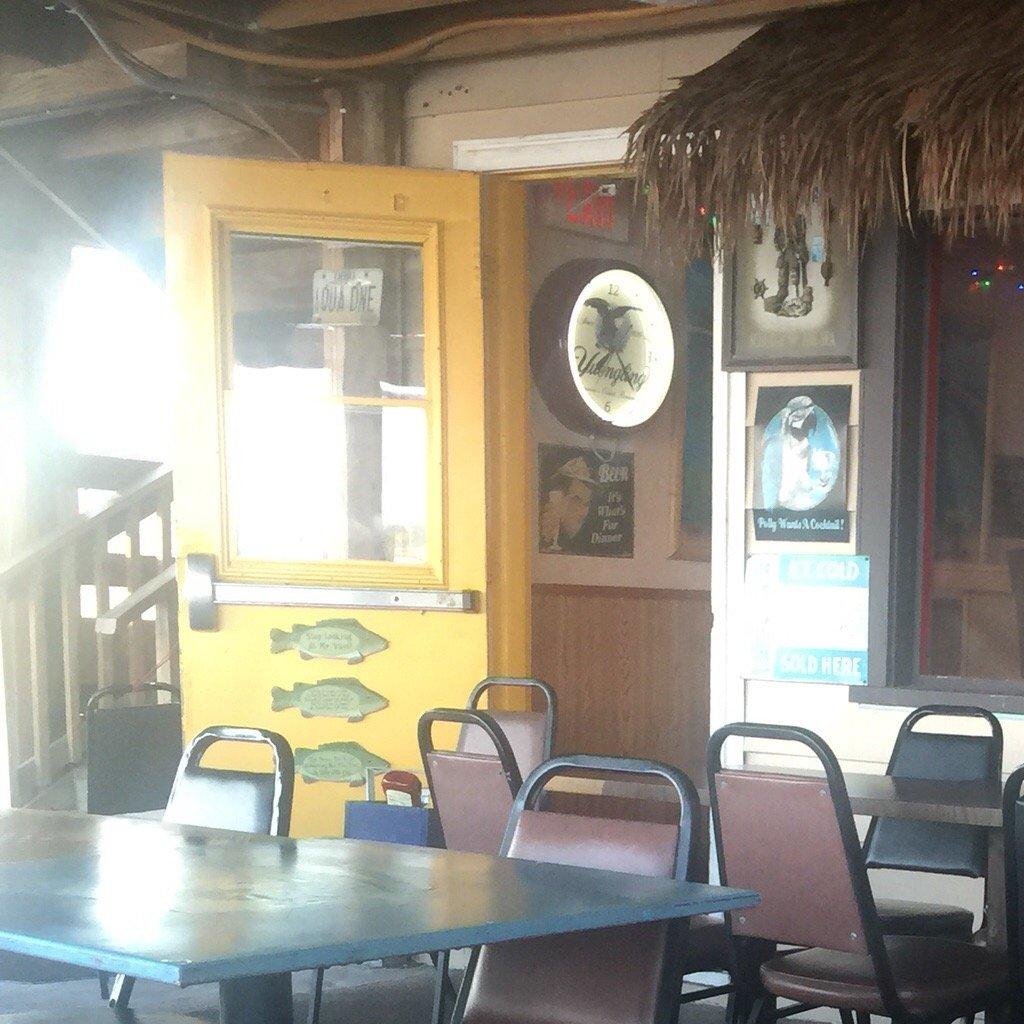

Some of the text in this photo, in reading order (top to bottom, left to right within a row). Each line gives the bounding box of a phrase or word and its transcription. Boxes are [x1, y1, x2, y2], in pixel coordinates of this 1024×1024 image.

[608, 283, 619, 296] 12
[604, 401, 611, 413] 6
[602, 519, 619, 531] For
[757, 517, 776, 532] Polly
[778, 518, 802, 529] Wants
[802, 518, 809, 529] A
[591, 532, 623, 544] Dinner
[821, 655, 862, 678] HERE
